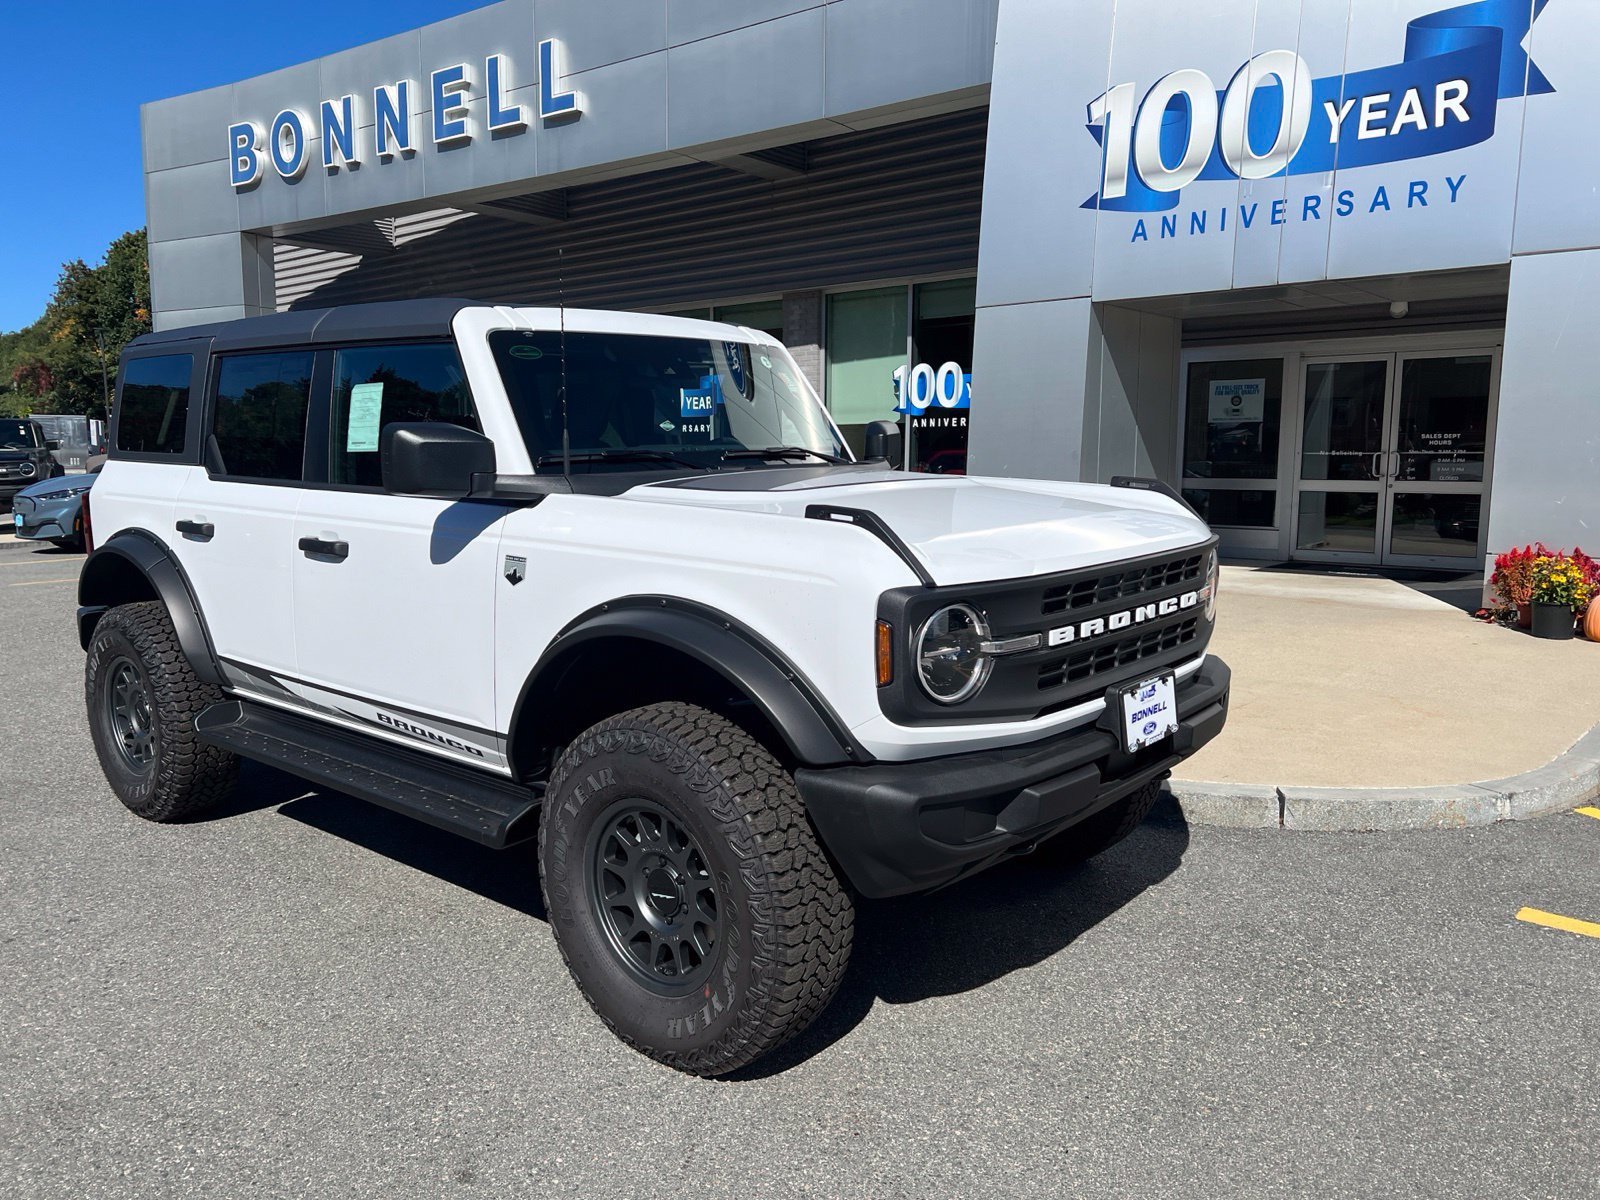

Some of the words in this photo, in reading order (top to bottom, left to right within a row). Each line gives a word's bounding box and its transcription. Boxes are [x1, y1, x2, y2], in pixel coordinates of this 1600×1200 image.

[228, 38, 582, 187] BONNELL
[1086, 49, 1312, 200] 100
[1322, 79, 1471, 144] YEAR
[1131, 174, 1468, 243] ANNIVERSARY
[685, 396, 712, 410] YEAR
[893, 361, 964, 409] 100
[682, 424, 710, 433] RSARY
[912, 417, 967, 428] ANNIVER
[1048, 591, 1198, 647] BRONCO
[376, 712, 484, 758] BRONCO
[1131, 701, 1168, 724] BONNELL
